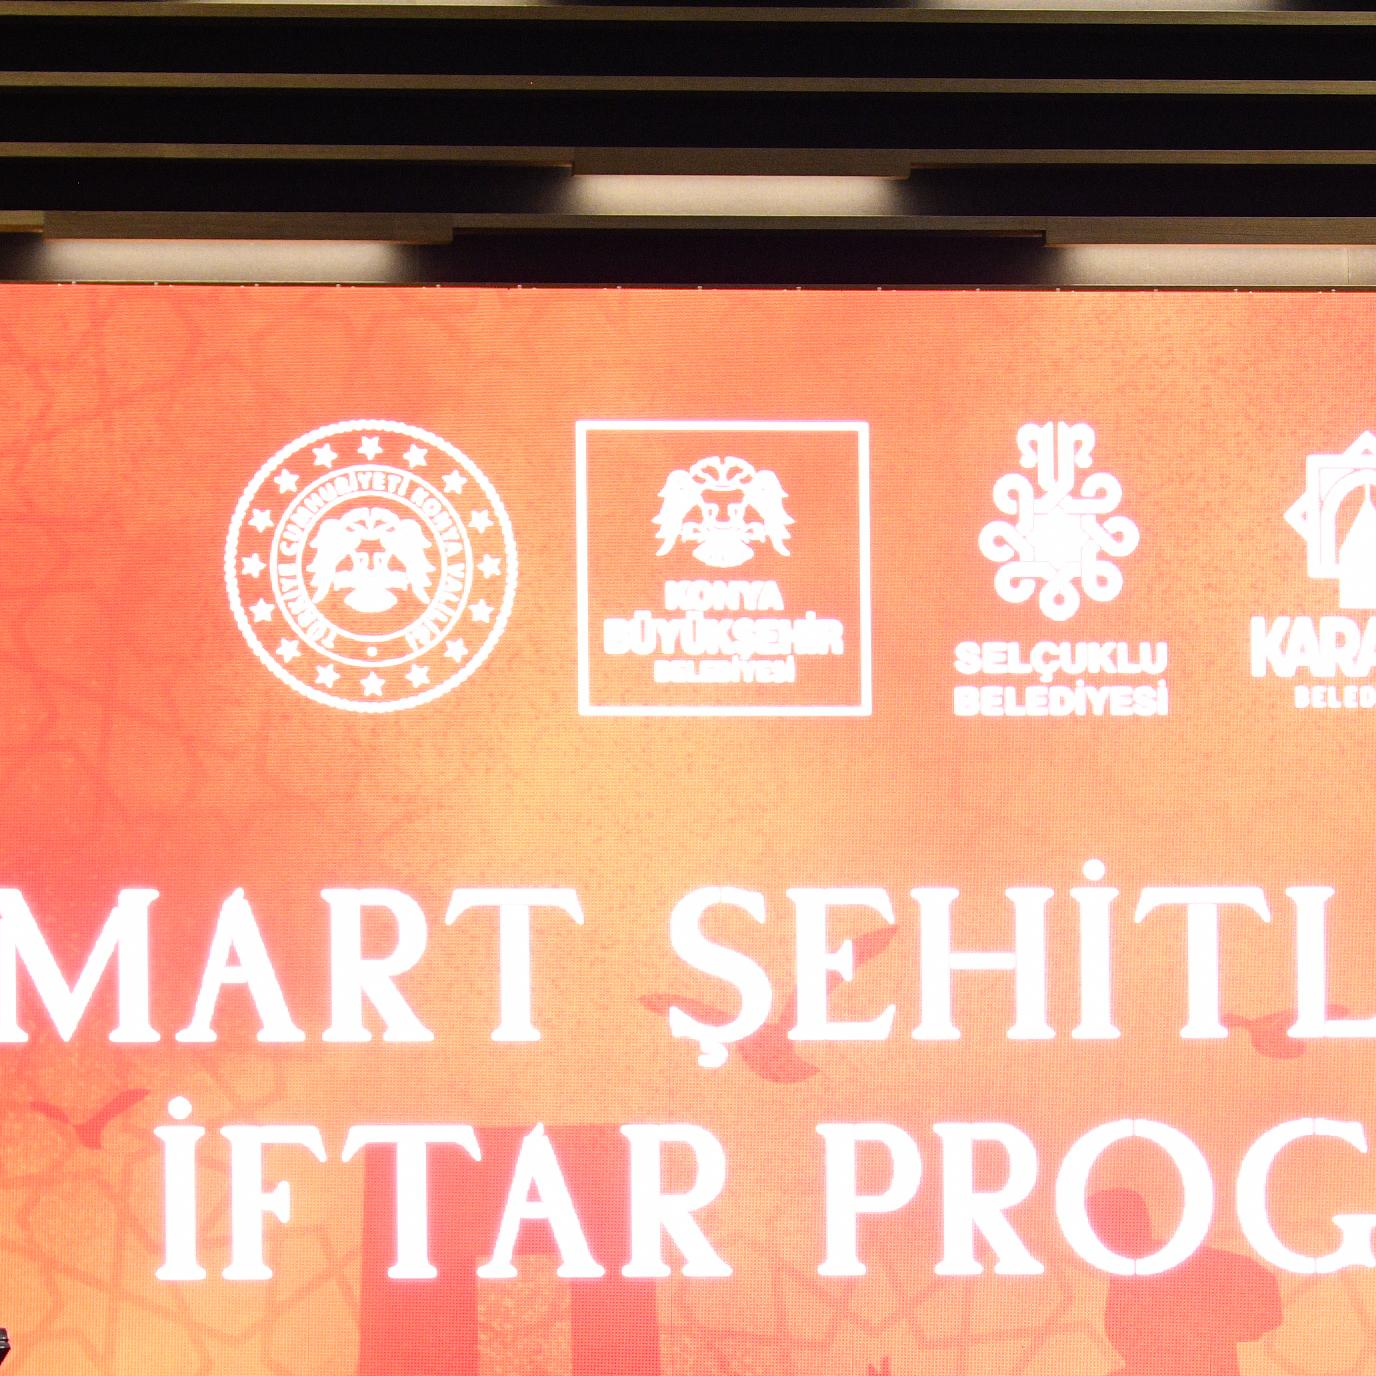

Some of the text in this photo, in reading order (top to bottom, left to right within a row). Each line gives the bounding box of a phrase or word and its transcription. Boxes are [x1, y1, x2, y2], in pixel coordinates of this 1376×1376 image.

[410, 486, 464, 558] KONYA
[664, 579, 784, 611] KONYA
[603, 609, 844, 660] BÜYÜKŞEHİR
[653, 655, 796, 684] BELEDİYESİ
[953, 640, 1169, 682] SELÇUKLU
[953, 680, 1169, 717] BELEDİYESİ
[154, 1095, 734, 1282] İFTAR
